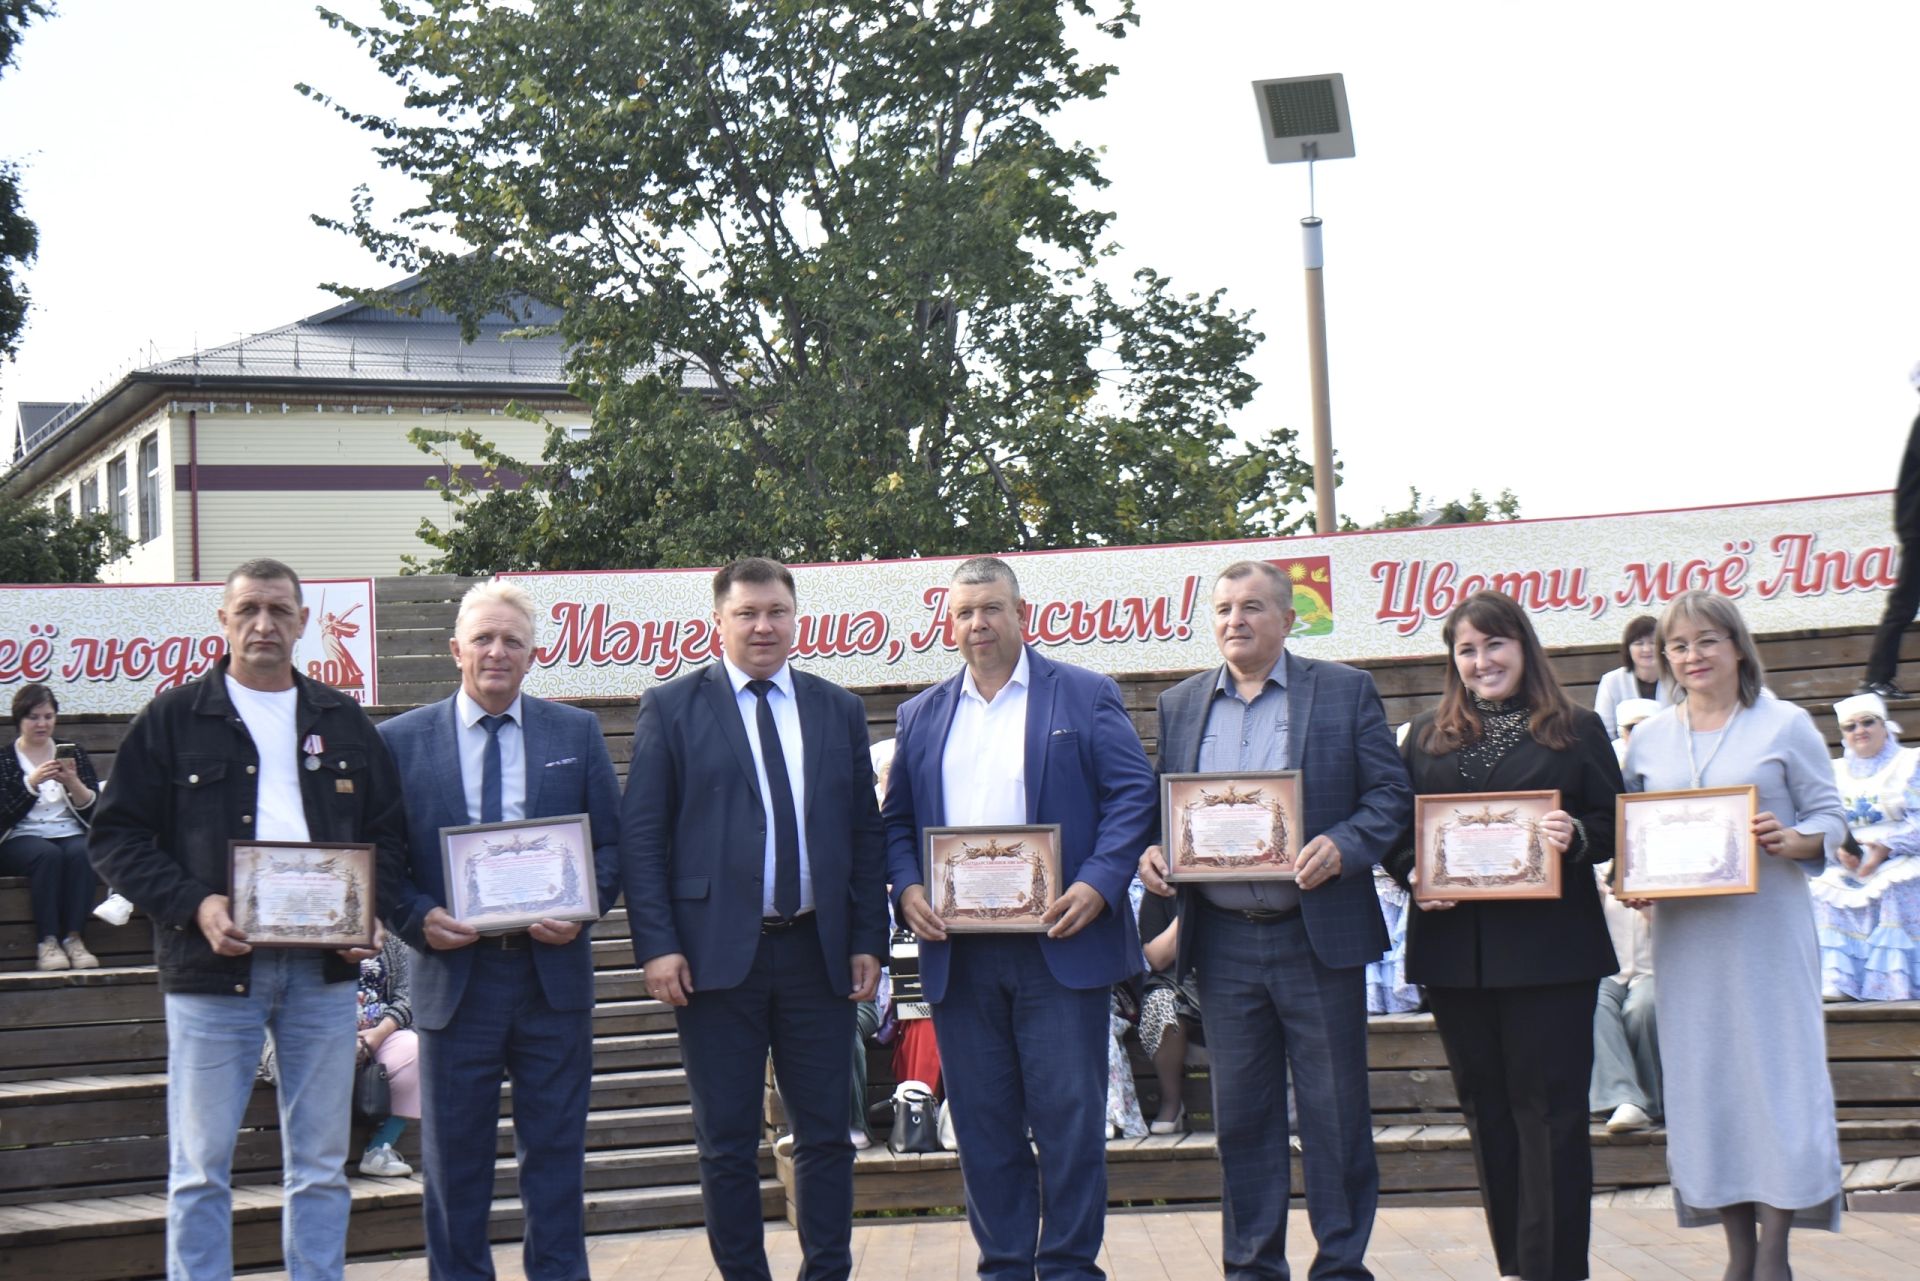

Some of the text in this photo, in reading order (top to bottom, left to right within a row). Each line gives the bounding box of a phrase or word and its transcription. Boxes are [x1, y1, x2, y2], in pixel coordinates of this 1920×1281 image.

[788, 608, 903, 662] шә,
[910, 575, 1201, 650] Асым!
[1371, 533, 1901, 634] Цвети, моё Апа
[61, 635, 225, 696] людя
[307, 659, 338, 687] 80
